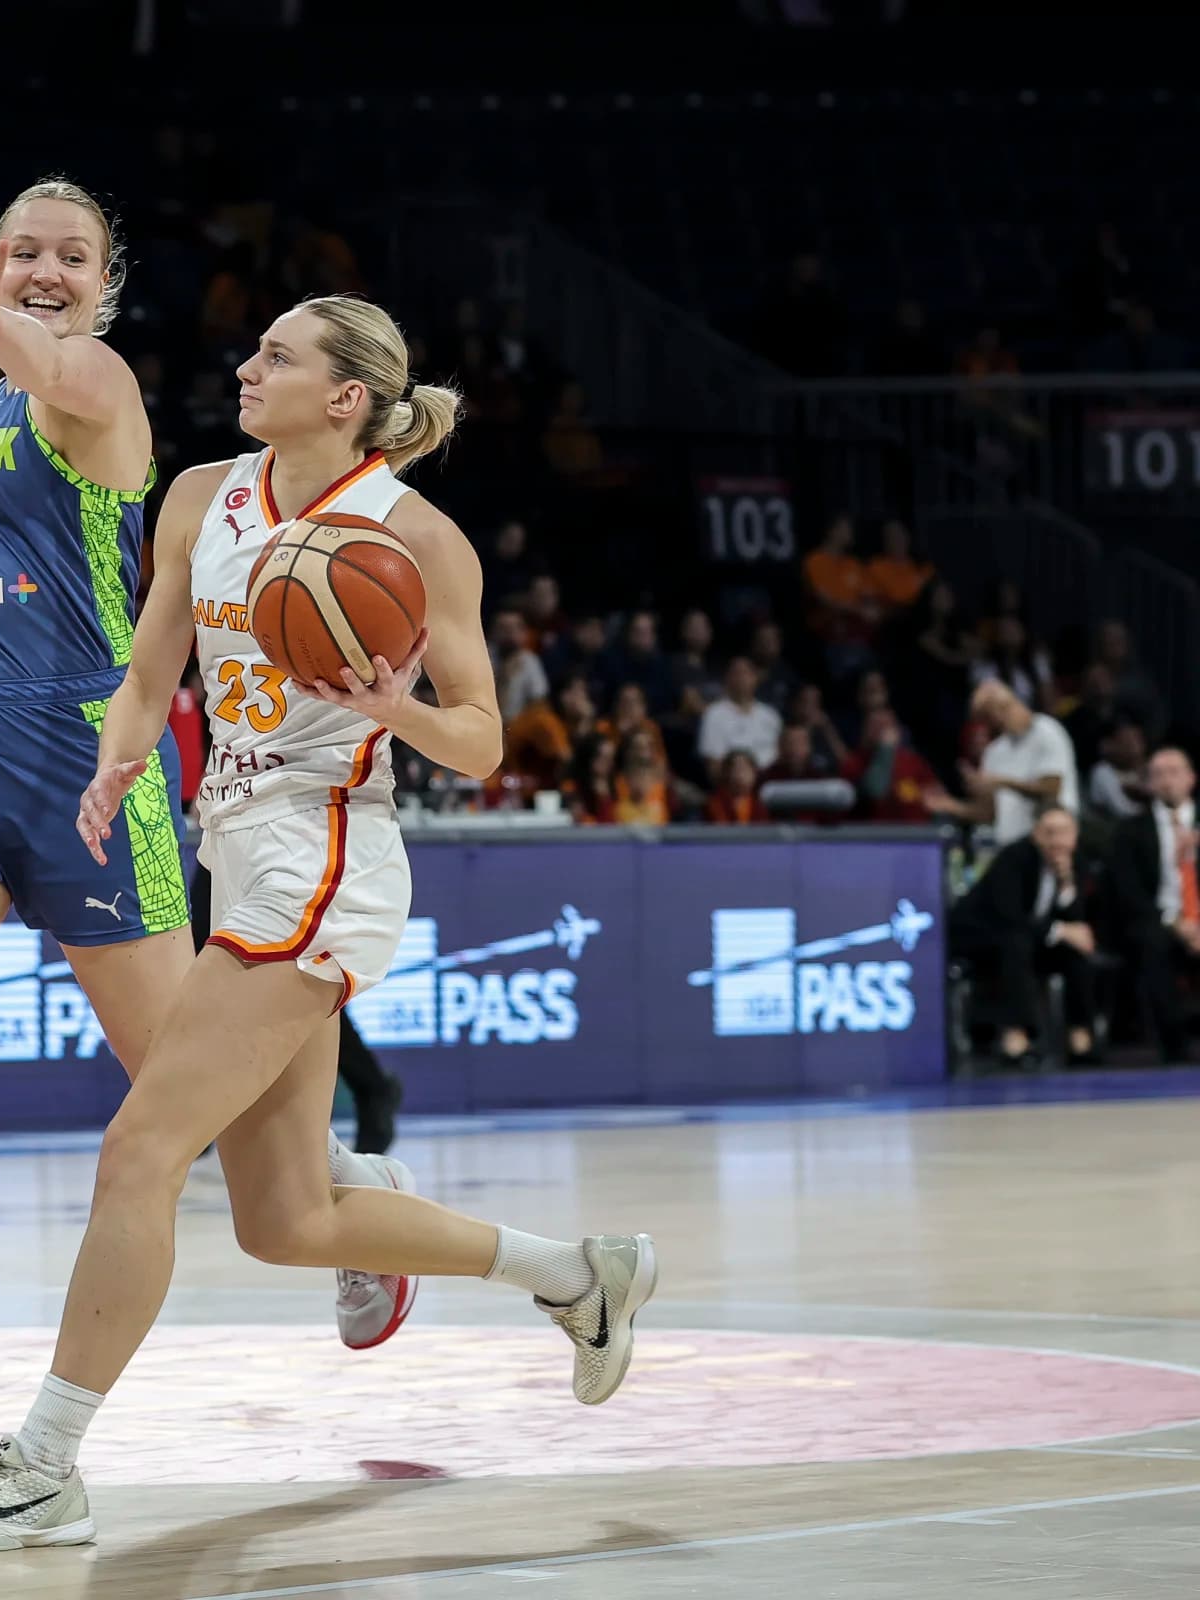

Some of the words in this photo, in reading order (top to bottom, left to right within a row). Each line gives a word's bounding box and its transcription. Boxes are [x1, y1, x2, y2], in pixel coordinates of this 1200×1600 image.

[704, 497, 796, 562] 103
[213, 660, 289, 733] 23
[440, 969, 579, 1045] PASS
[797, 961, 916, 1033] PASS
